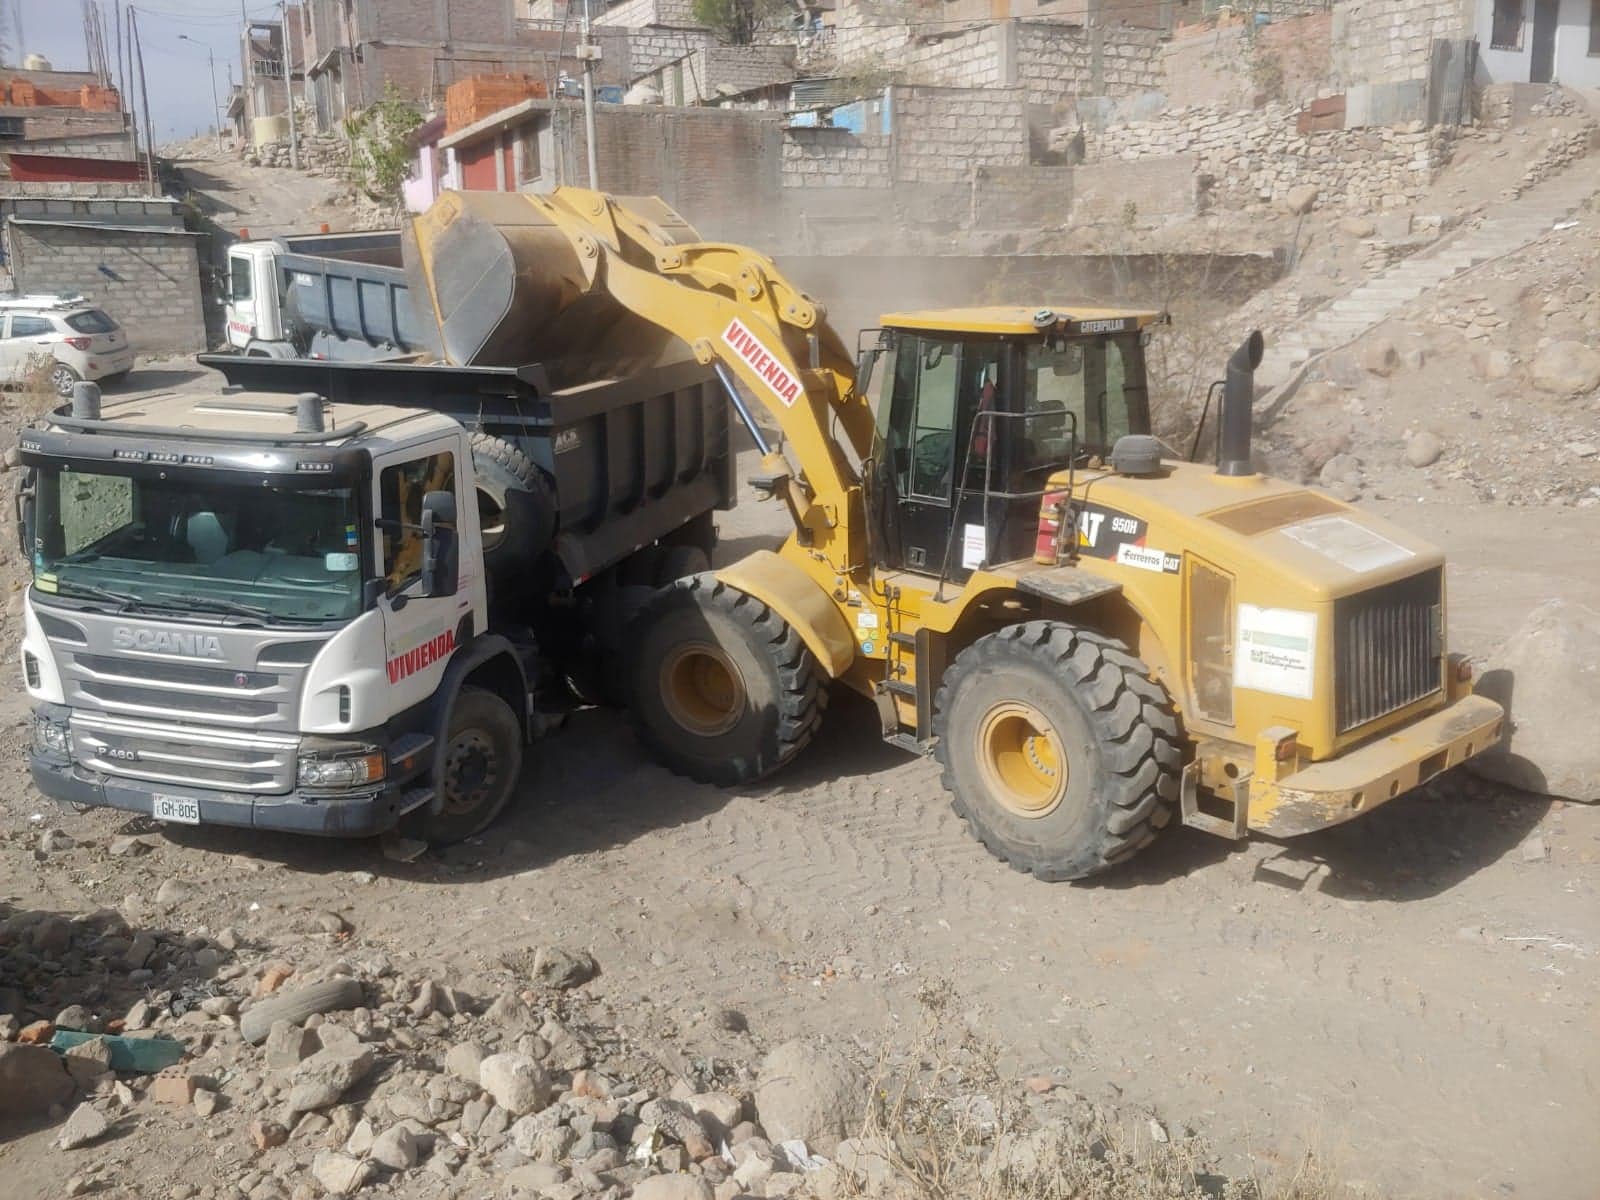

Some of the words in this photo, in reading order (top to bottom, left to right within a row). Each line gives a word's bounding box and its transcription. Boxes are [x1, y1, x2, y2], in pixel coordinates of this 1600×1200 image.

[725, 321, 799, 403] VIVIENDA
[1079, 511, 1105, 547] AT
[1111, 517, 1139, 535] 950H
[112, 626, 225, 657] SCANIA
[387, 628, 456, 685] VIVIENDA
